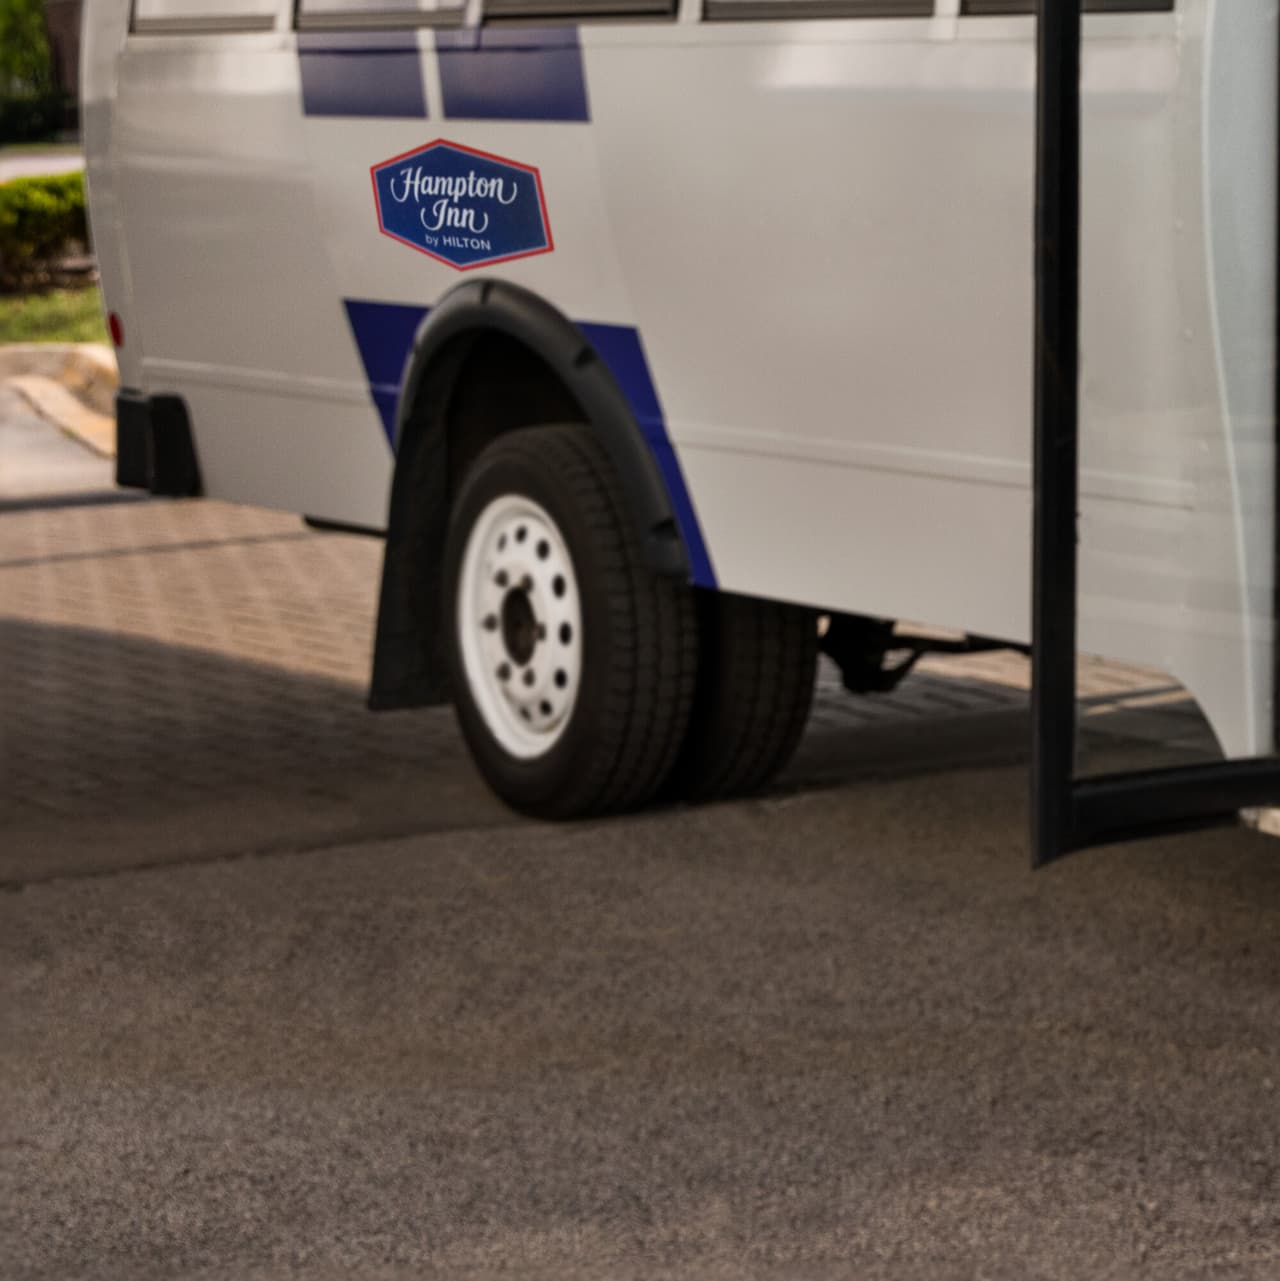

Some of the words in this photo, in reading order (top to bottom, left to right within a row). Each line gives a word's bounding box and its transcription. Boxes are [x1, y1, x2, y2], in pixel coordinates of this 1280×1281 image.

[390, 166, 518, 205] Hampton
[420, 198, 489, 234] Inn
[425, 234, 439, 247] by
[442, 235, 491, 251] HILTON
